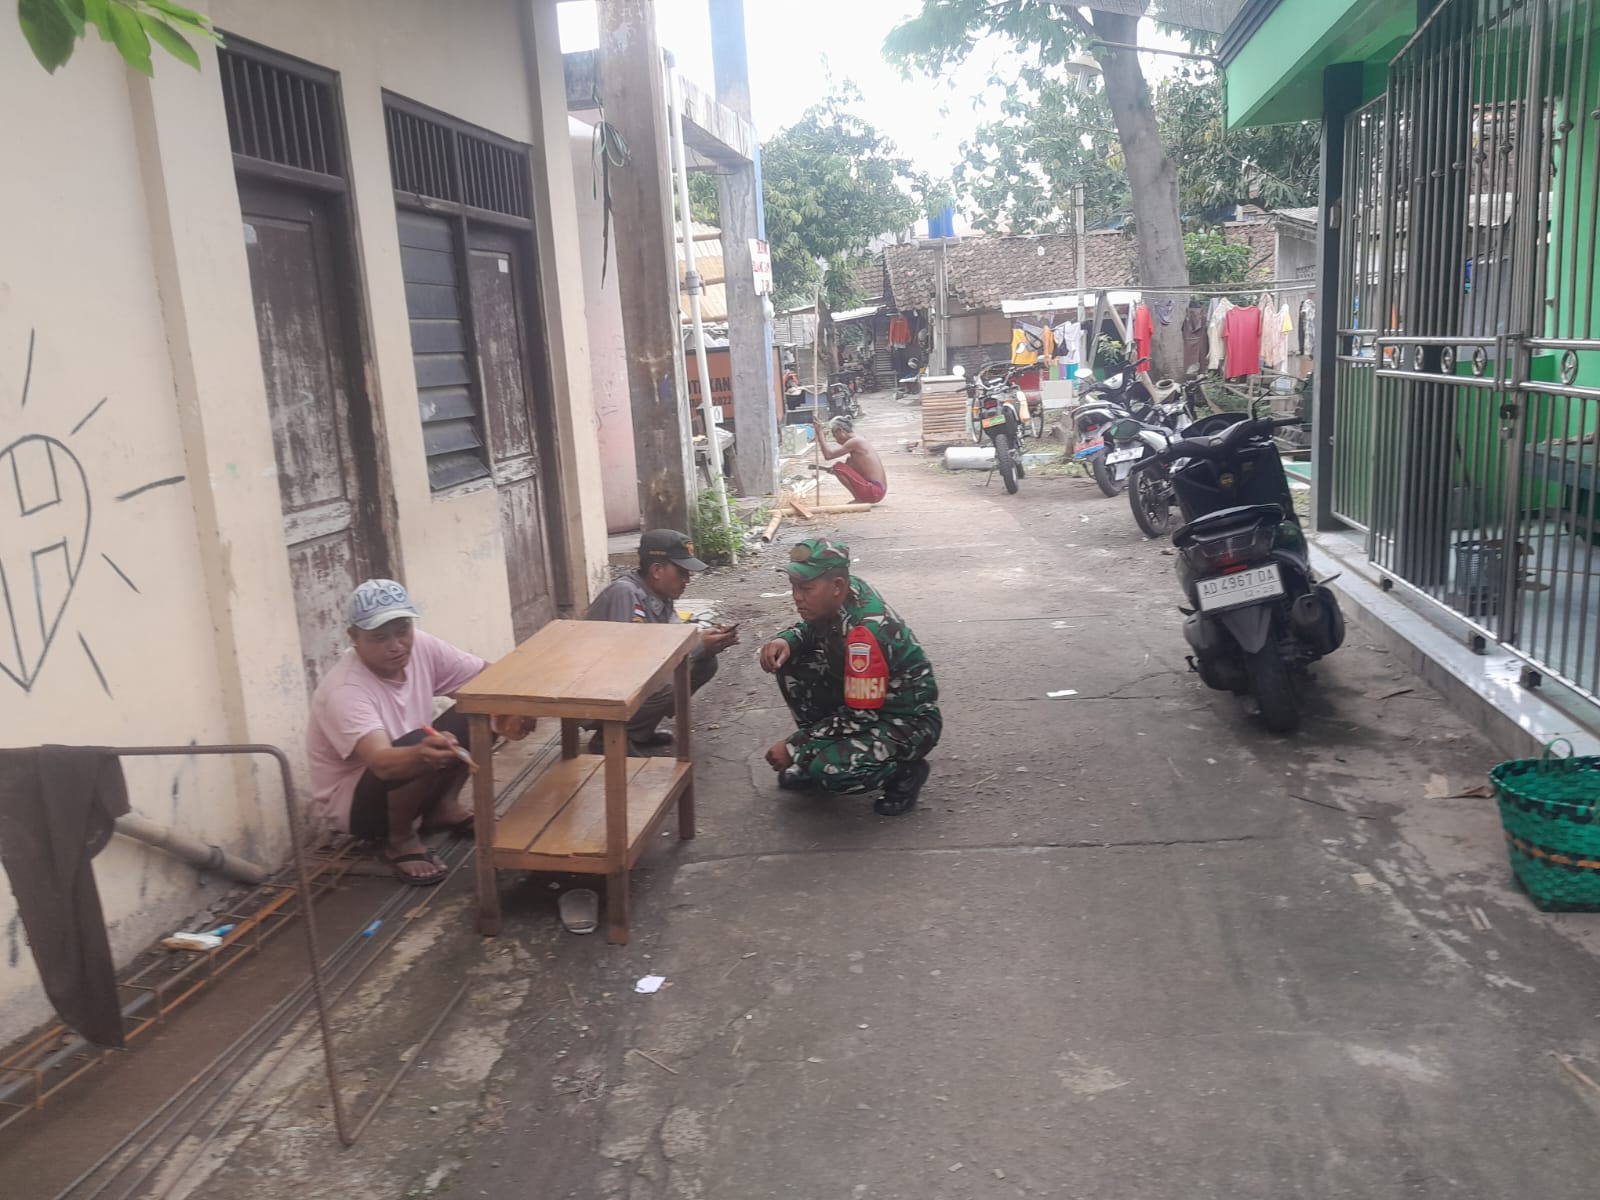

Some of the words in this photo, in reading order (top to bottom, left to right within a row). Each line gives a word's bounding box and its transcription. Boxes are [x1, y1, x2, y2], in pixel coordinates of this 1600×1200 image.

[1203, 582, 1218, 597] AD
[1222, 573, 1254, 591] 4967
[1258, 568, 1275, 582] DA
